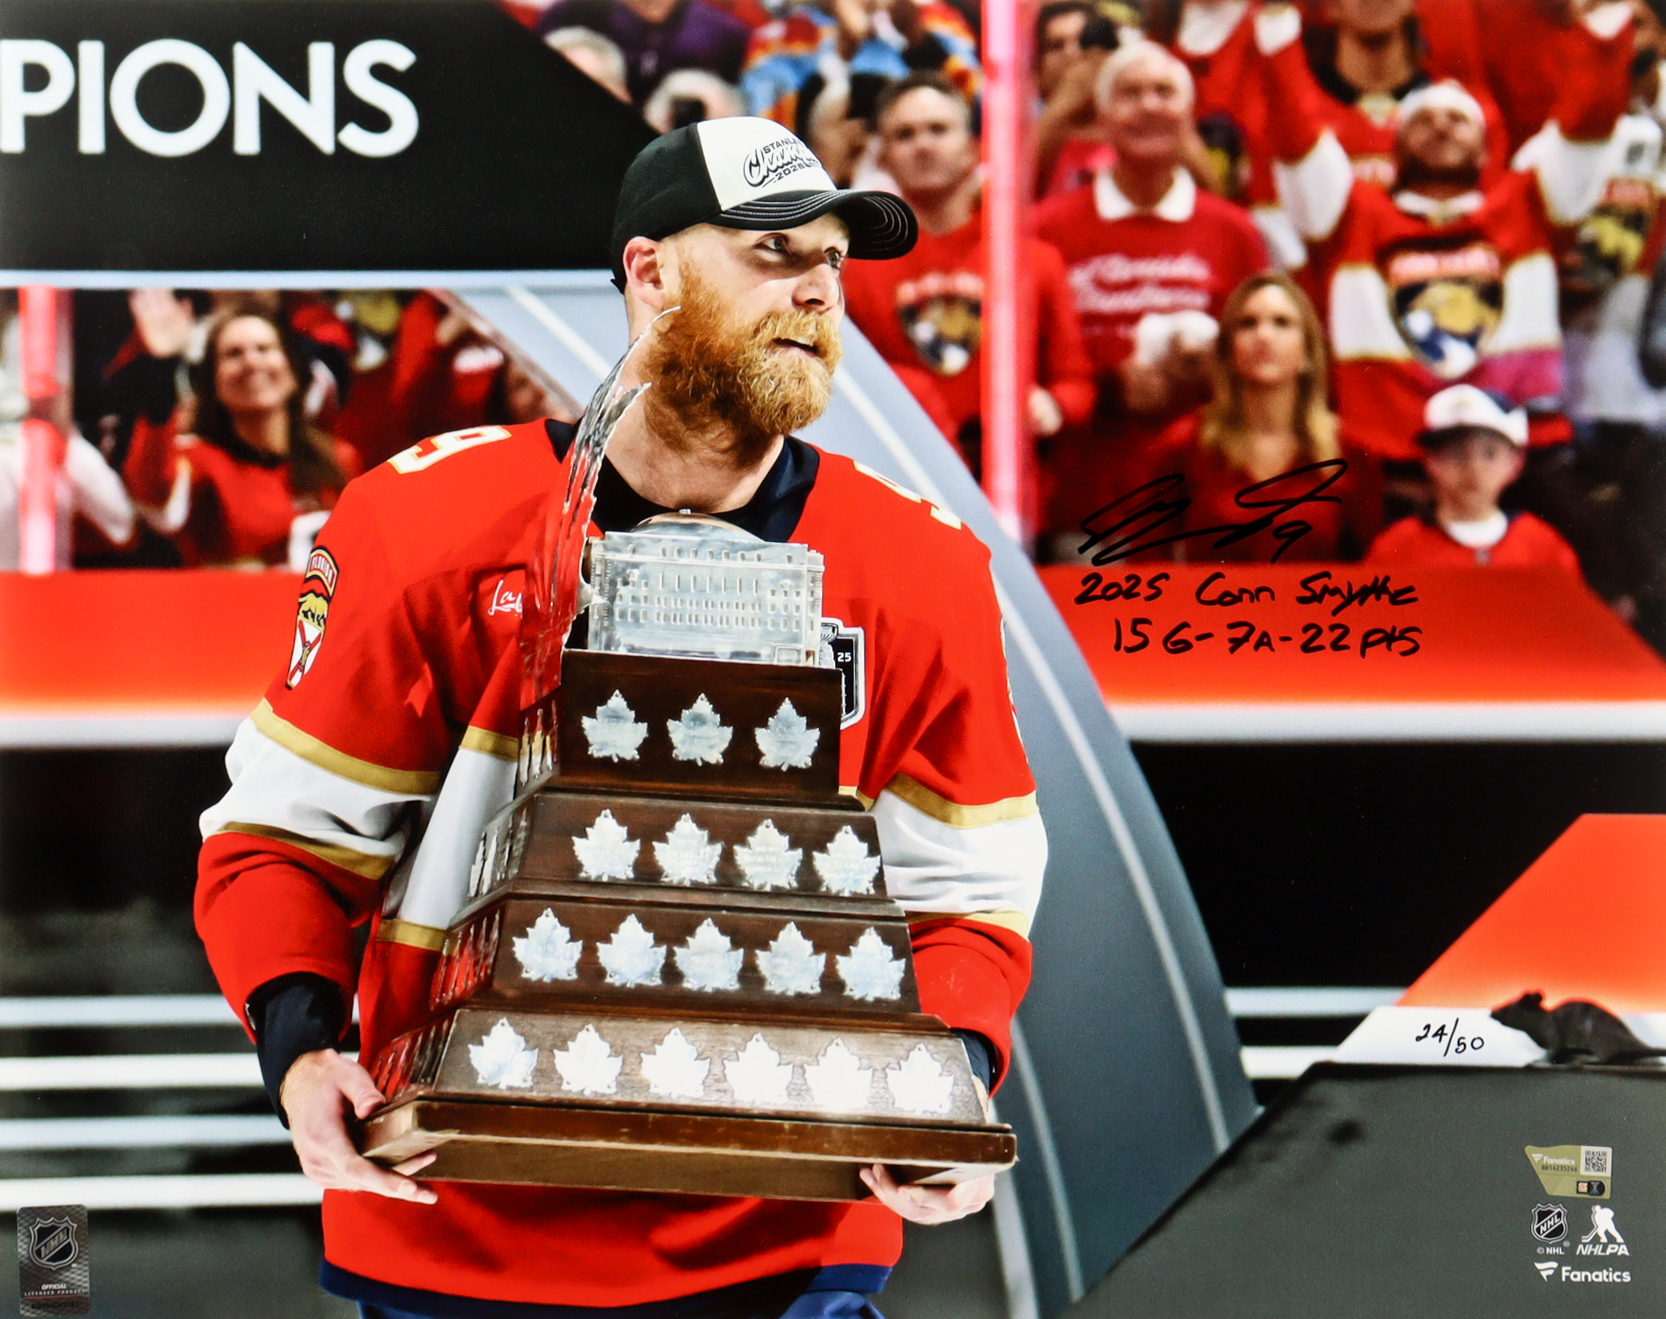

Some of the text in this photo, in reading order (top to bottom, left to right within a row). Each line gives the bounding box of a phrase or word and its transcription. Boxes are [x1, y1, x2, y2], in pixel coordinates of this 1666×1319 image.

[0, 38, 420, 158] PIONS
[387, 425, 512, 474] 9
[1074, 572, 1170, 604] 2025
[1196, 572, 1275, 606] Conn
[837, 652, 852, 662] 25
[1415, 1017, 1485, 1057] 24/50
[1543, 1155, 1576, 1165] Fanatics
